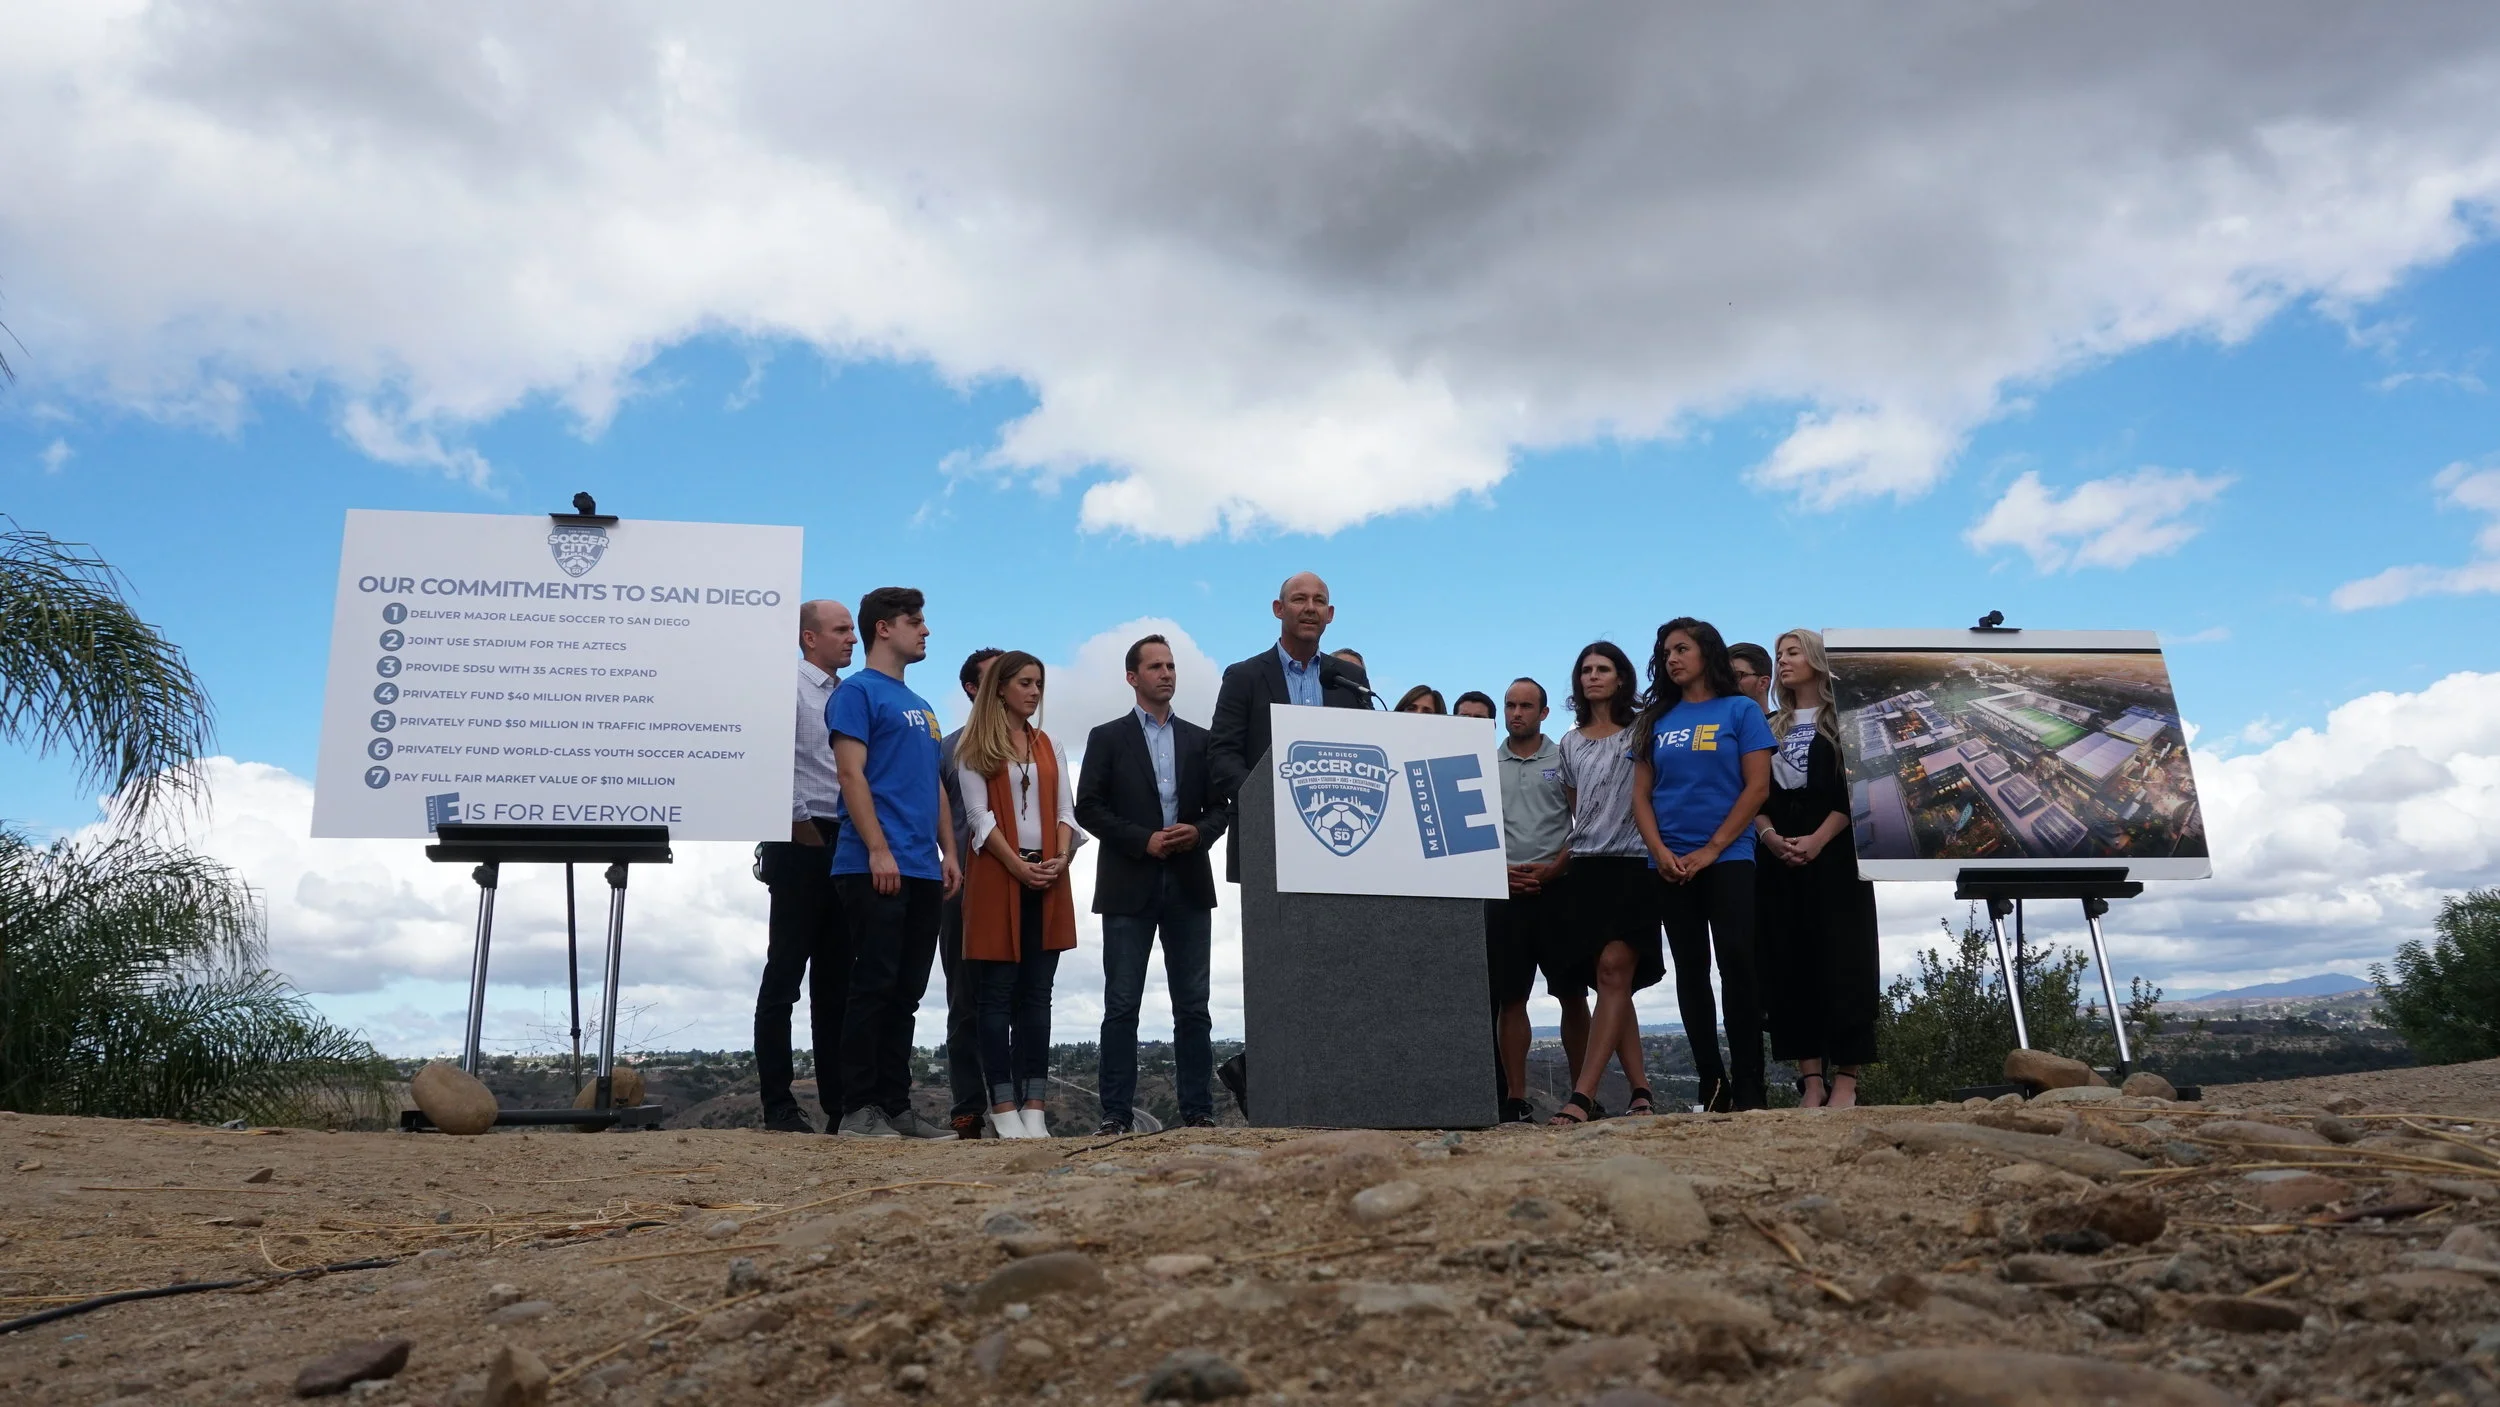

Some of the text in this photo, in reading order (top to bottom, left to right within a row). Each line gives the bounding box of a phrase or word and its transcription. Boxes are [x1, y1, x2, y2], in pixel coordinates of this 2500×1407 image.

[548, 534, 609, 548] SOCCER
[560, 543, 595, 553] CITY
[358, 576, 781, 606] OUR COMMITMENTS TO SAN DIEGO
[390, 606, 690, 627] 1 DELIVER MAJOR LEAGUE SOCCER TO SAN DIEGO
[385, 633, 627, 651] 2 JOINT USE STADIUM FOR THE AZTECS
[382, 659, 657, 678] 3 PROVIDE SDSU WITH 35 ACRES TO EXPAND
[379, 686, 655, 704] 4 PRIVATELY FUND $40 MILLION RIVER PARK
[376, 714, 742, 733] 5 PRIVATELY FUND $50 MILLION IN TRAFFIC IMPROVEMENTS
[902, 709, 925, 727] YES
[1657, 728, 1692, 749] YES
[1699, 723, 1720, 751] E
[374, 741, 746, 759] 6 PRIVATELY FUND WORLD-CLASS YOUTH SOCCER ACADEMY
[371, 769, 675, 786] 7 PAY FULL FAIR MARKET VALUE OF $110 MILLION
[1280, 759, 1396, 783] SOCCER CITY
[1339, 784, 1371, 793] TAXPAYERS
[436, 792, 682, 824] E IS FOR EVERYONE
[1412, 767, 1439, 851] MEASURE
[1428, 753, 1501, 856] E
[1334, 831, 1350, 841] SD
